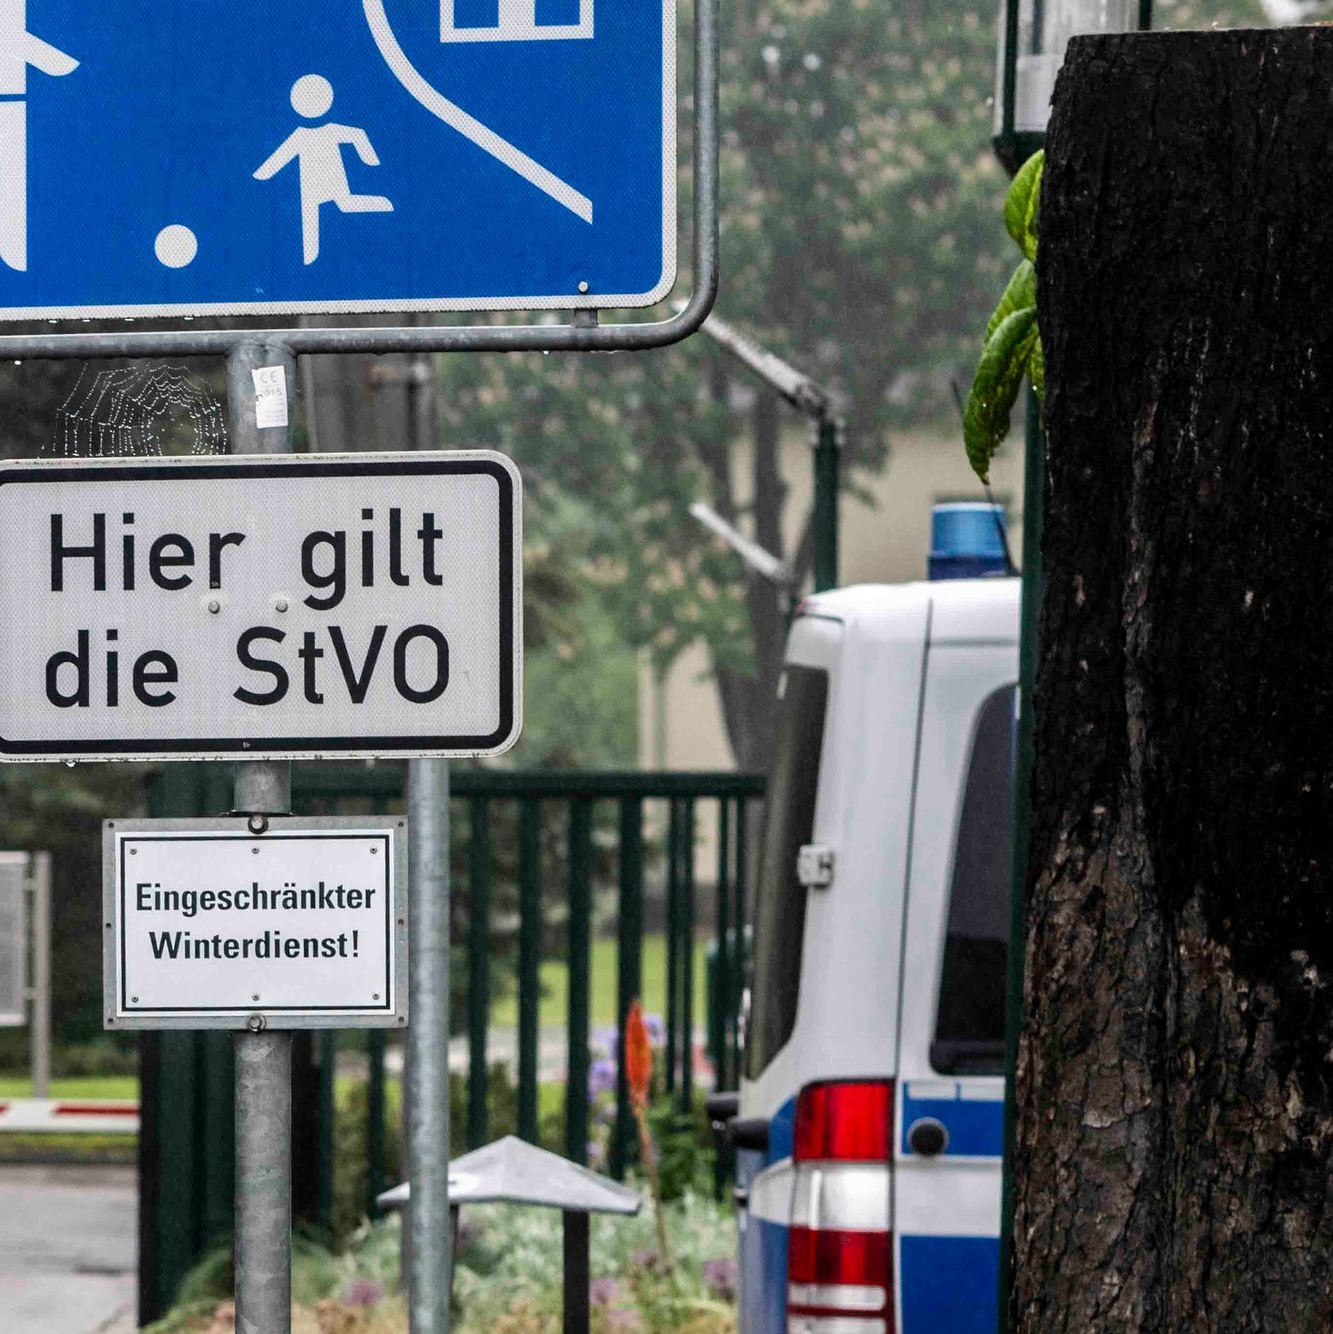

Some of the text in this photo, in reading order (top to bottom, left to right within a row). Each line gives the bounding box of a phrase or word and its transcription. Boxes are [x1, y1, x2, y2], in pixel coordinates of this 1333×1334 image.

[50, 507, 444, 611] Hier gilt
[44, 624, 450, 708] die StVO
[136, 881, 376, 918] Eingeschränkter
[149, 930, 360, 961] Winterdienst!
